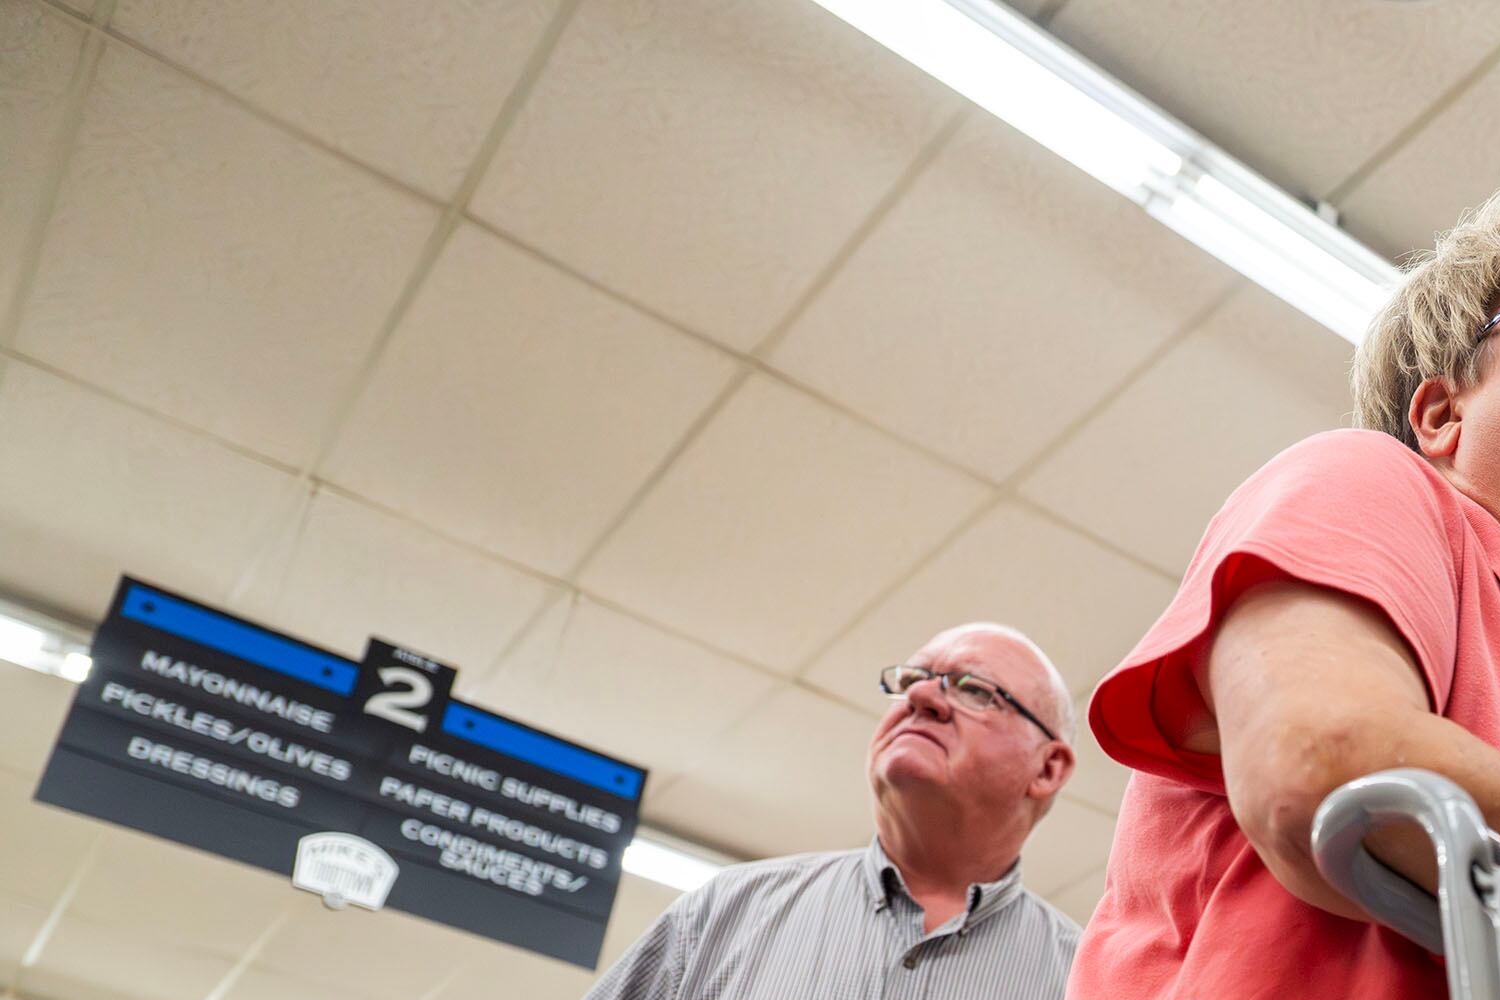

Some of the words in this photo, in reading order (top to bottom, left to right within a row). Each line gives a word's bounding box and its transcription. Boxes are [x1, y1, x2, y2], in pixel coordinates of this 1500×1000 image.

[101, 681, 353, 782] PICKLES/OLIVES
[141, 650, 336, 734] MAYONNAISE
[363, 666, 434, 734] 2
[127, 735, 301, 808] DRESSINGS
[408, 743, 500, 792] PICNIC
[500, 777, 622, 834] SUPPLIES
[379, 775, 471, 824] PAPER
[470, 806, 609, 870] PRODUCTS
[438, 849, 544, 897] SAUCES
